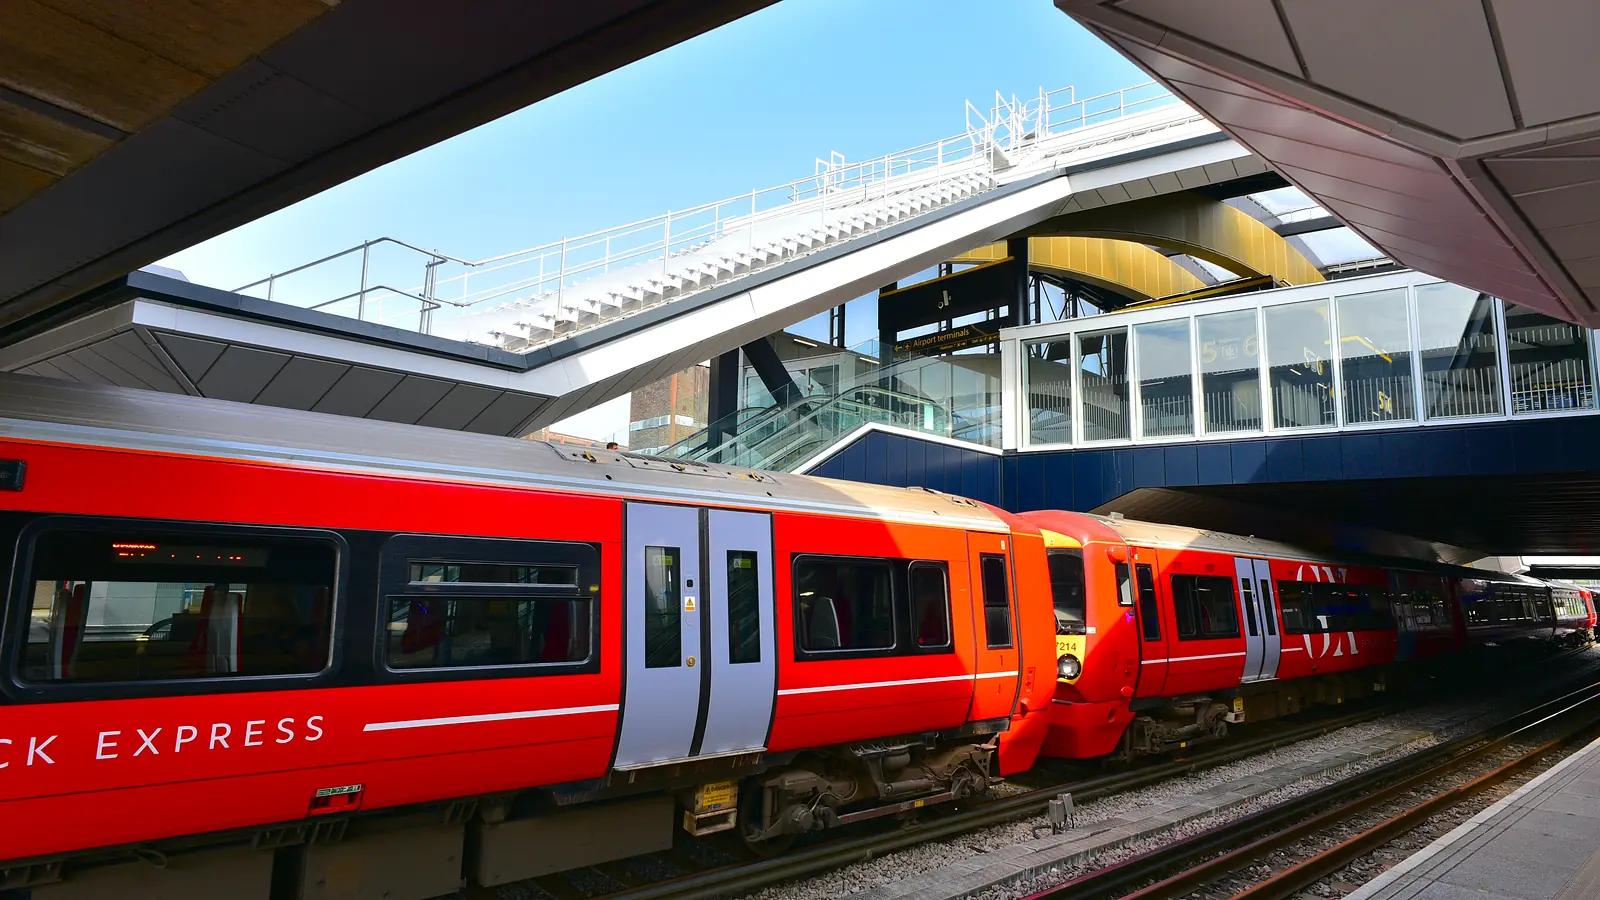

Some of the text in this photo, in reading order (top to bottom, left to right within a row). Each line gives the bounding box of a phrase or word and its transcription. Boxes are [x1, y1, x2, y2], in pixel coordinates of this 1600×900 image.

[913, 336, 936, 347] Airport
[937, 328, 969, 343] terminals
[1201, 334, 1257, 363] 5 6
[95, 715, 324, 760] EXPRESS
